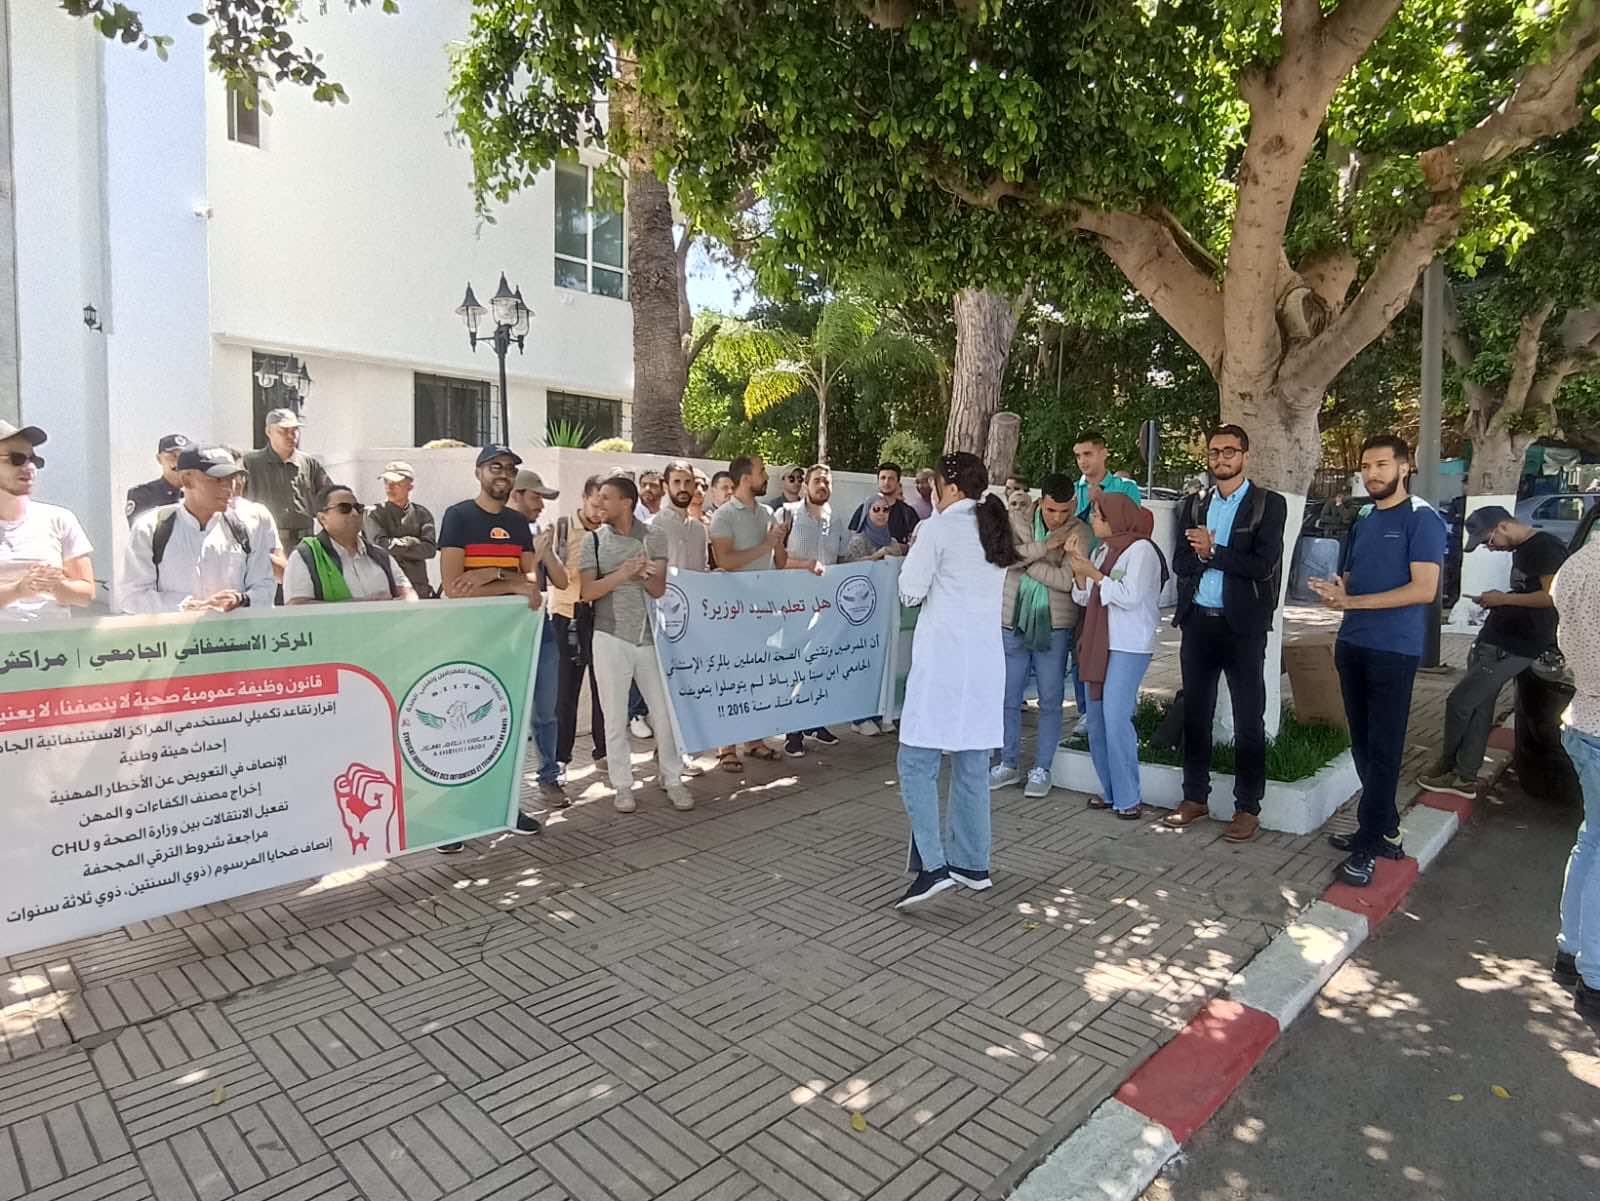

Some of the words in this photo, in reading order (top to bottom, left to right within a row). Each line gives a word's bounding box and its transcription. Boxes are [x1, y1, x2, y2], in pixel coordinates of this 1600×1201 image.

[749, 600, 777, 619] السيد
[780, 599, 806, 620] تعلم
[812, 596, 831, 613] هل
[271, 631, 313, 653] المركز
[0, 649, 68, 675] مراكش
[90, 641, 167, 671] الجامعي
[809, 669, 824, 682] سينا
[826, 664, 839, 681] ابن
[842, 658, 871, 679] الجامعي
[238, 679, 283, 699] وظيفة
[287, 674, 323, 694] قانون
[751, 674, 763, 695] لم
[120, 693, 130, 709] لا
[133, 689, 180, 710] صحية
[182, 685, 236, 705] عمومية
[39, 700, 50, 718] لا
[244, 708, 281, 727] تكميلي
[283, 704, 312, 718] تقاعد
[312, 700, 337, 716] إقرار
[727, 702, 750, 717] 2016
[127, 720, 173, 740] المراكز
[175, 712, 242, 736] لمستخدمي
[160, 745, 189, 759] هيئة
[190, 737, 227, 753] إحداث
[119, 750, 158, 766] وطنية
[245, 755, 288, 772] الإنصاف
[177, 764, 228, 785] التعويض
[230, 763, 244, 779] في
[106, 776, 153, 798] الأخطار
[154, 775, 175, 789] عن
[230, 782, 262, 801] إخراج
[49, 784, 103, 805] المهنية
[190, 790, 228, 804] مصنف
[135, 794, 188, 815] الكفاءات
[255, 800, 289, 819] تفعيل
[79, 806, 122, 827] المهن
[202, 807, 253, 827] الانتقالات
[150, 824, 178, 839] وزارة
[180, 820, 200, 835] بين
[103, 828, 147, 847] الصحة
[186, 837, 224, 854] شروط
[227, 830, 268, 845] مراجعة
[301, 837, 333, 854] إنصاف
[51, 839, 90, 856] CHU
[147, 845, 183, 866] الترقي
[267, 846, 299, 861] ضحايا
[83, 854, 144, 877] المجحفة
[214, 853, 265, 876] المرسوم
[62, 890, 92, 910] ثلاثة
[95, 885, 122, 907] ذوي
[6, 903, 60, 922] سنوات
